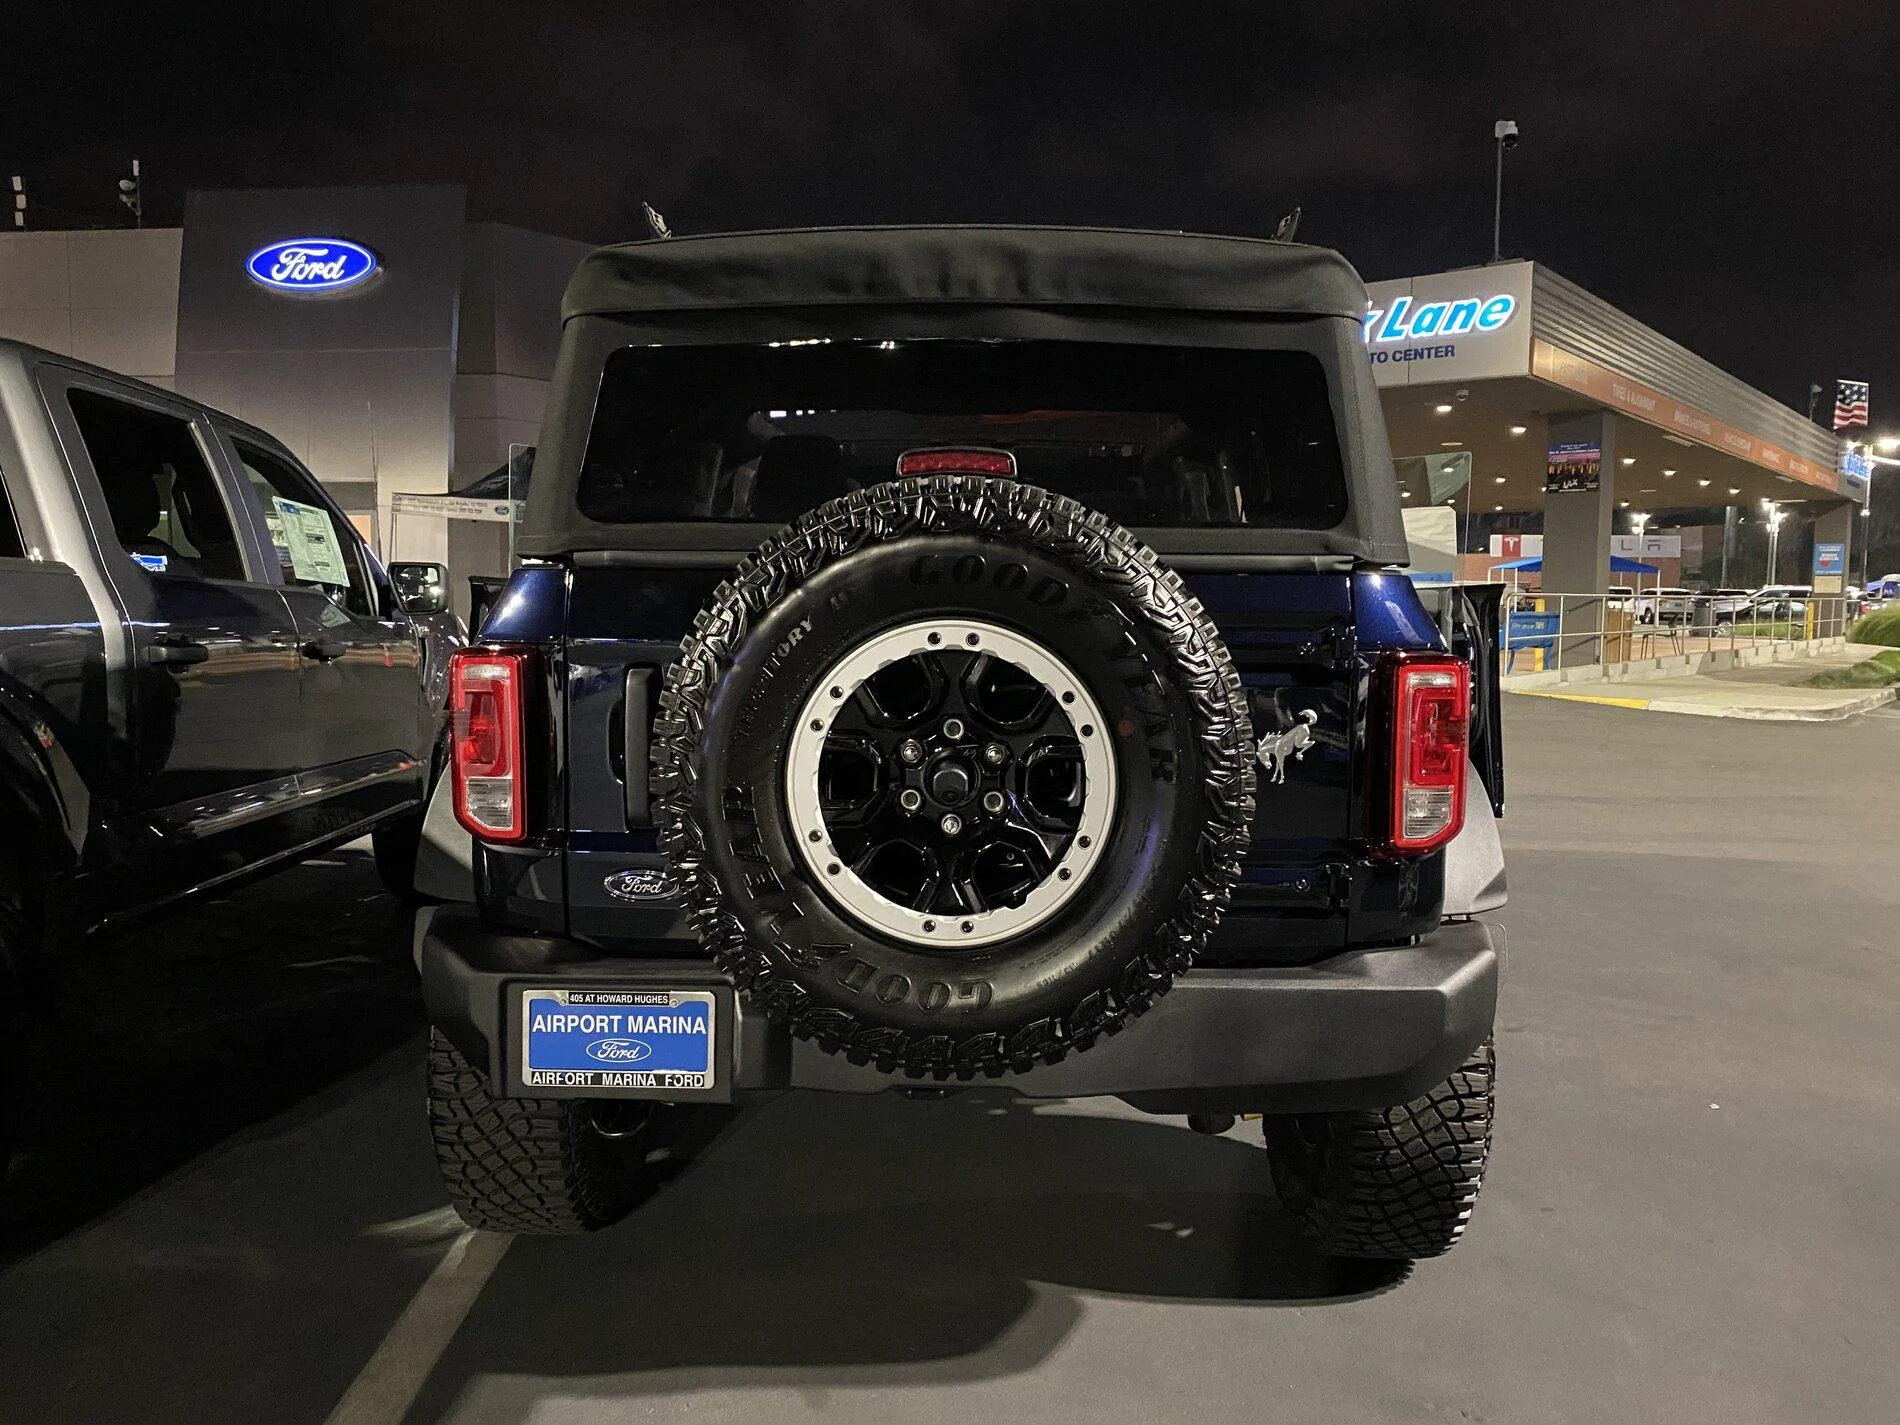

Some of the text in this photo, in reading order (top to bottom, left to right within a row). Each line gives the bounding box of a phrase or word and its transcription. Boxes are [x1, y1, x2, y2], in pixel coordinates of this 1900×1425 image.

[271, 247, 348, 281] Ford
[1376, 294, 1516, 343] Lane
[1370, 345, 1455, 365] TO CENTER
[621, 876, 664, 894] Ford
[569, 994, 669, 1004] 405 AT HOWARD HUGHES
[532, 1014, 707, 1035] AIRPORT MARINA
[597, 1039, 640, 1059] Ford
[602, 1073, 657, 1086] MARINA
[665, 1074, 704, 1087] FORD
